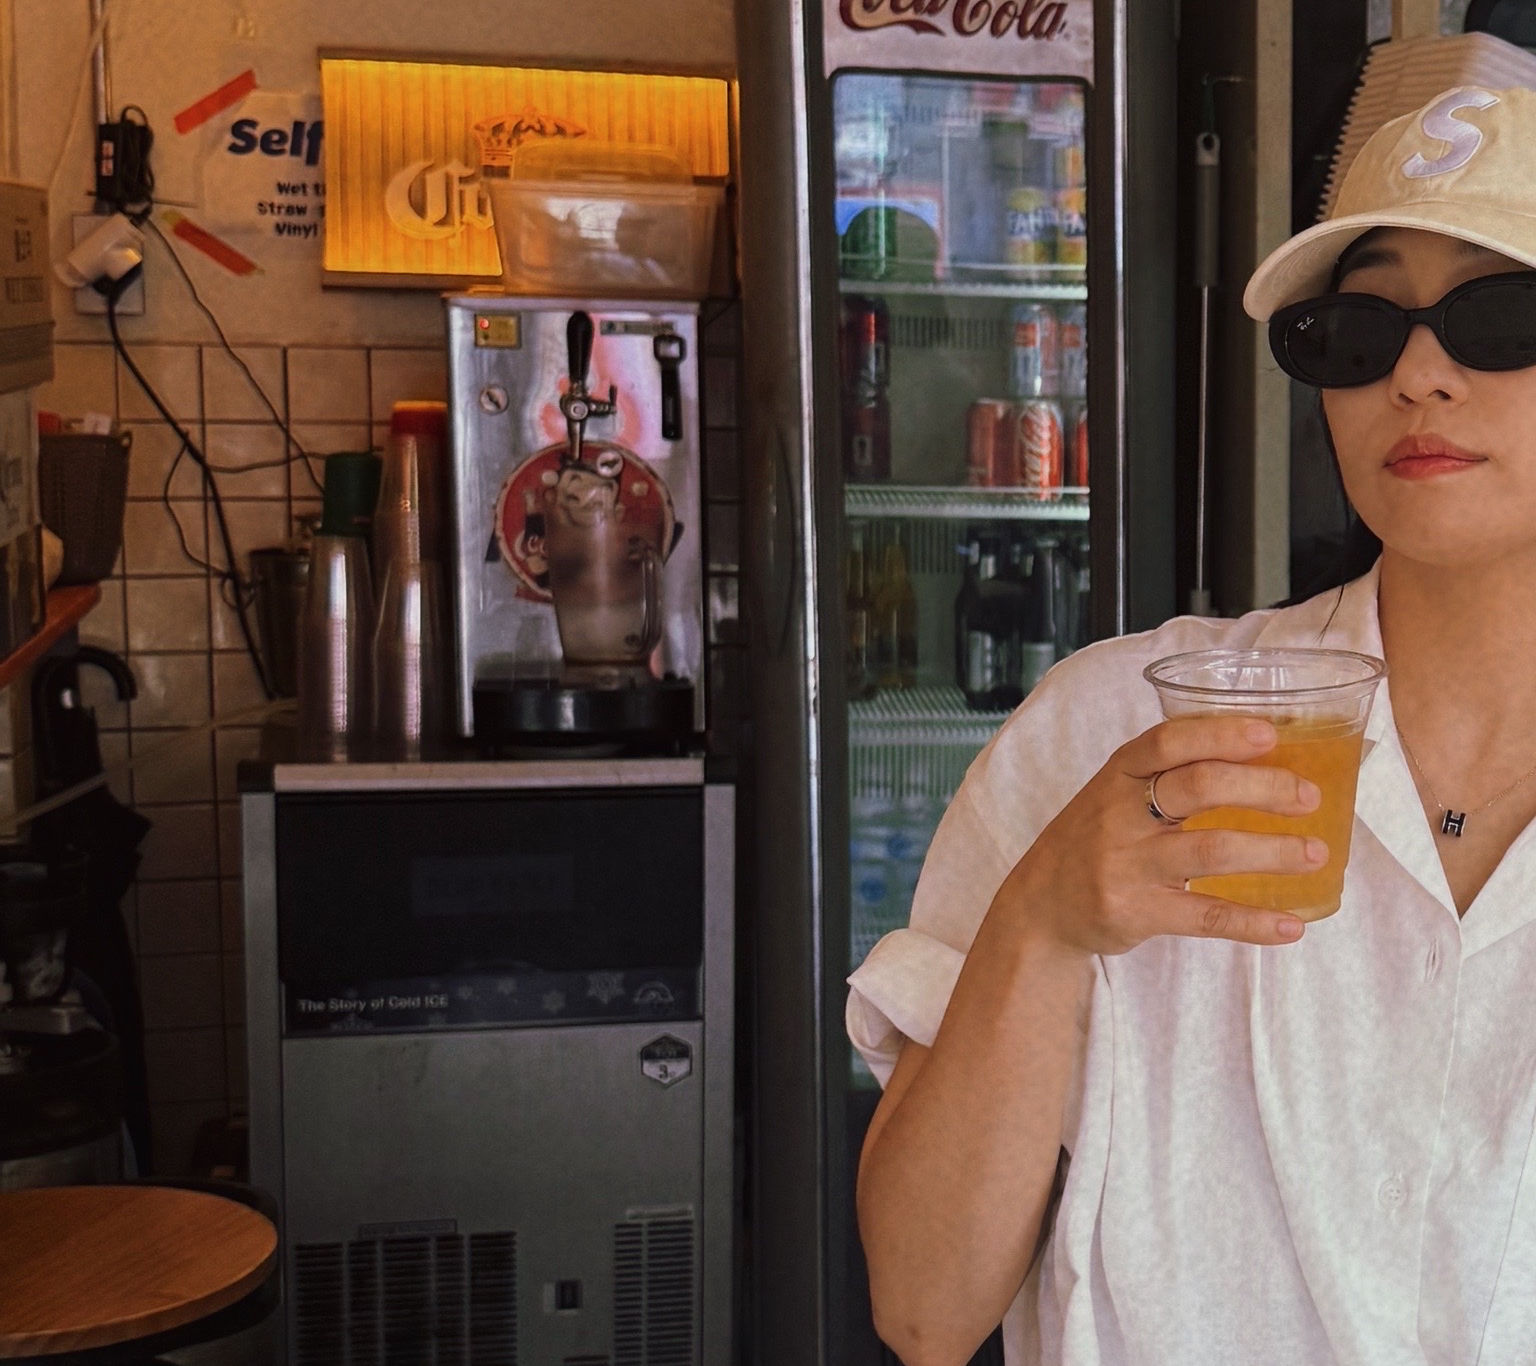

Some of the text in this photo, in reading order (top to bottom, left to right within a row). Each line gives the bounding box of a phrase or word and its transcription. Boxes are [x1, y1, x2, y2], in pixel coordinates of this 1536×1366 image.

[1400, 86, 1500, 180] S
[298, 996, 326, 1014] The
[328, 996, 367, 1015] Story
[370, 996, 385, 1011] of
[424, 993, 449, 1010] ICE
